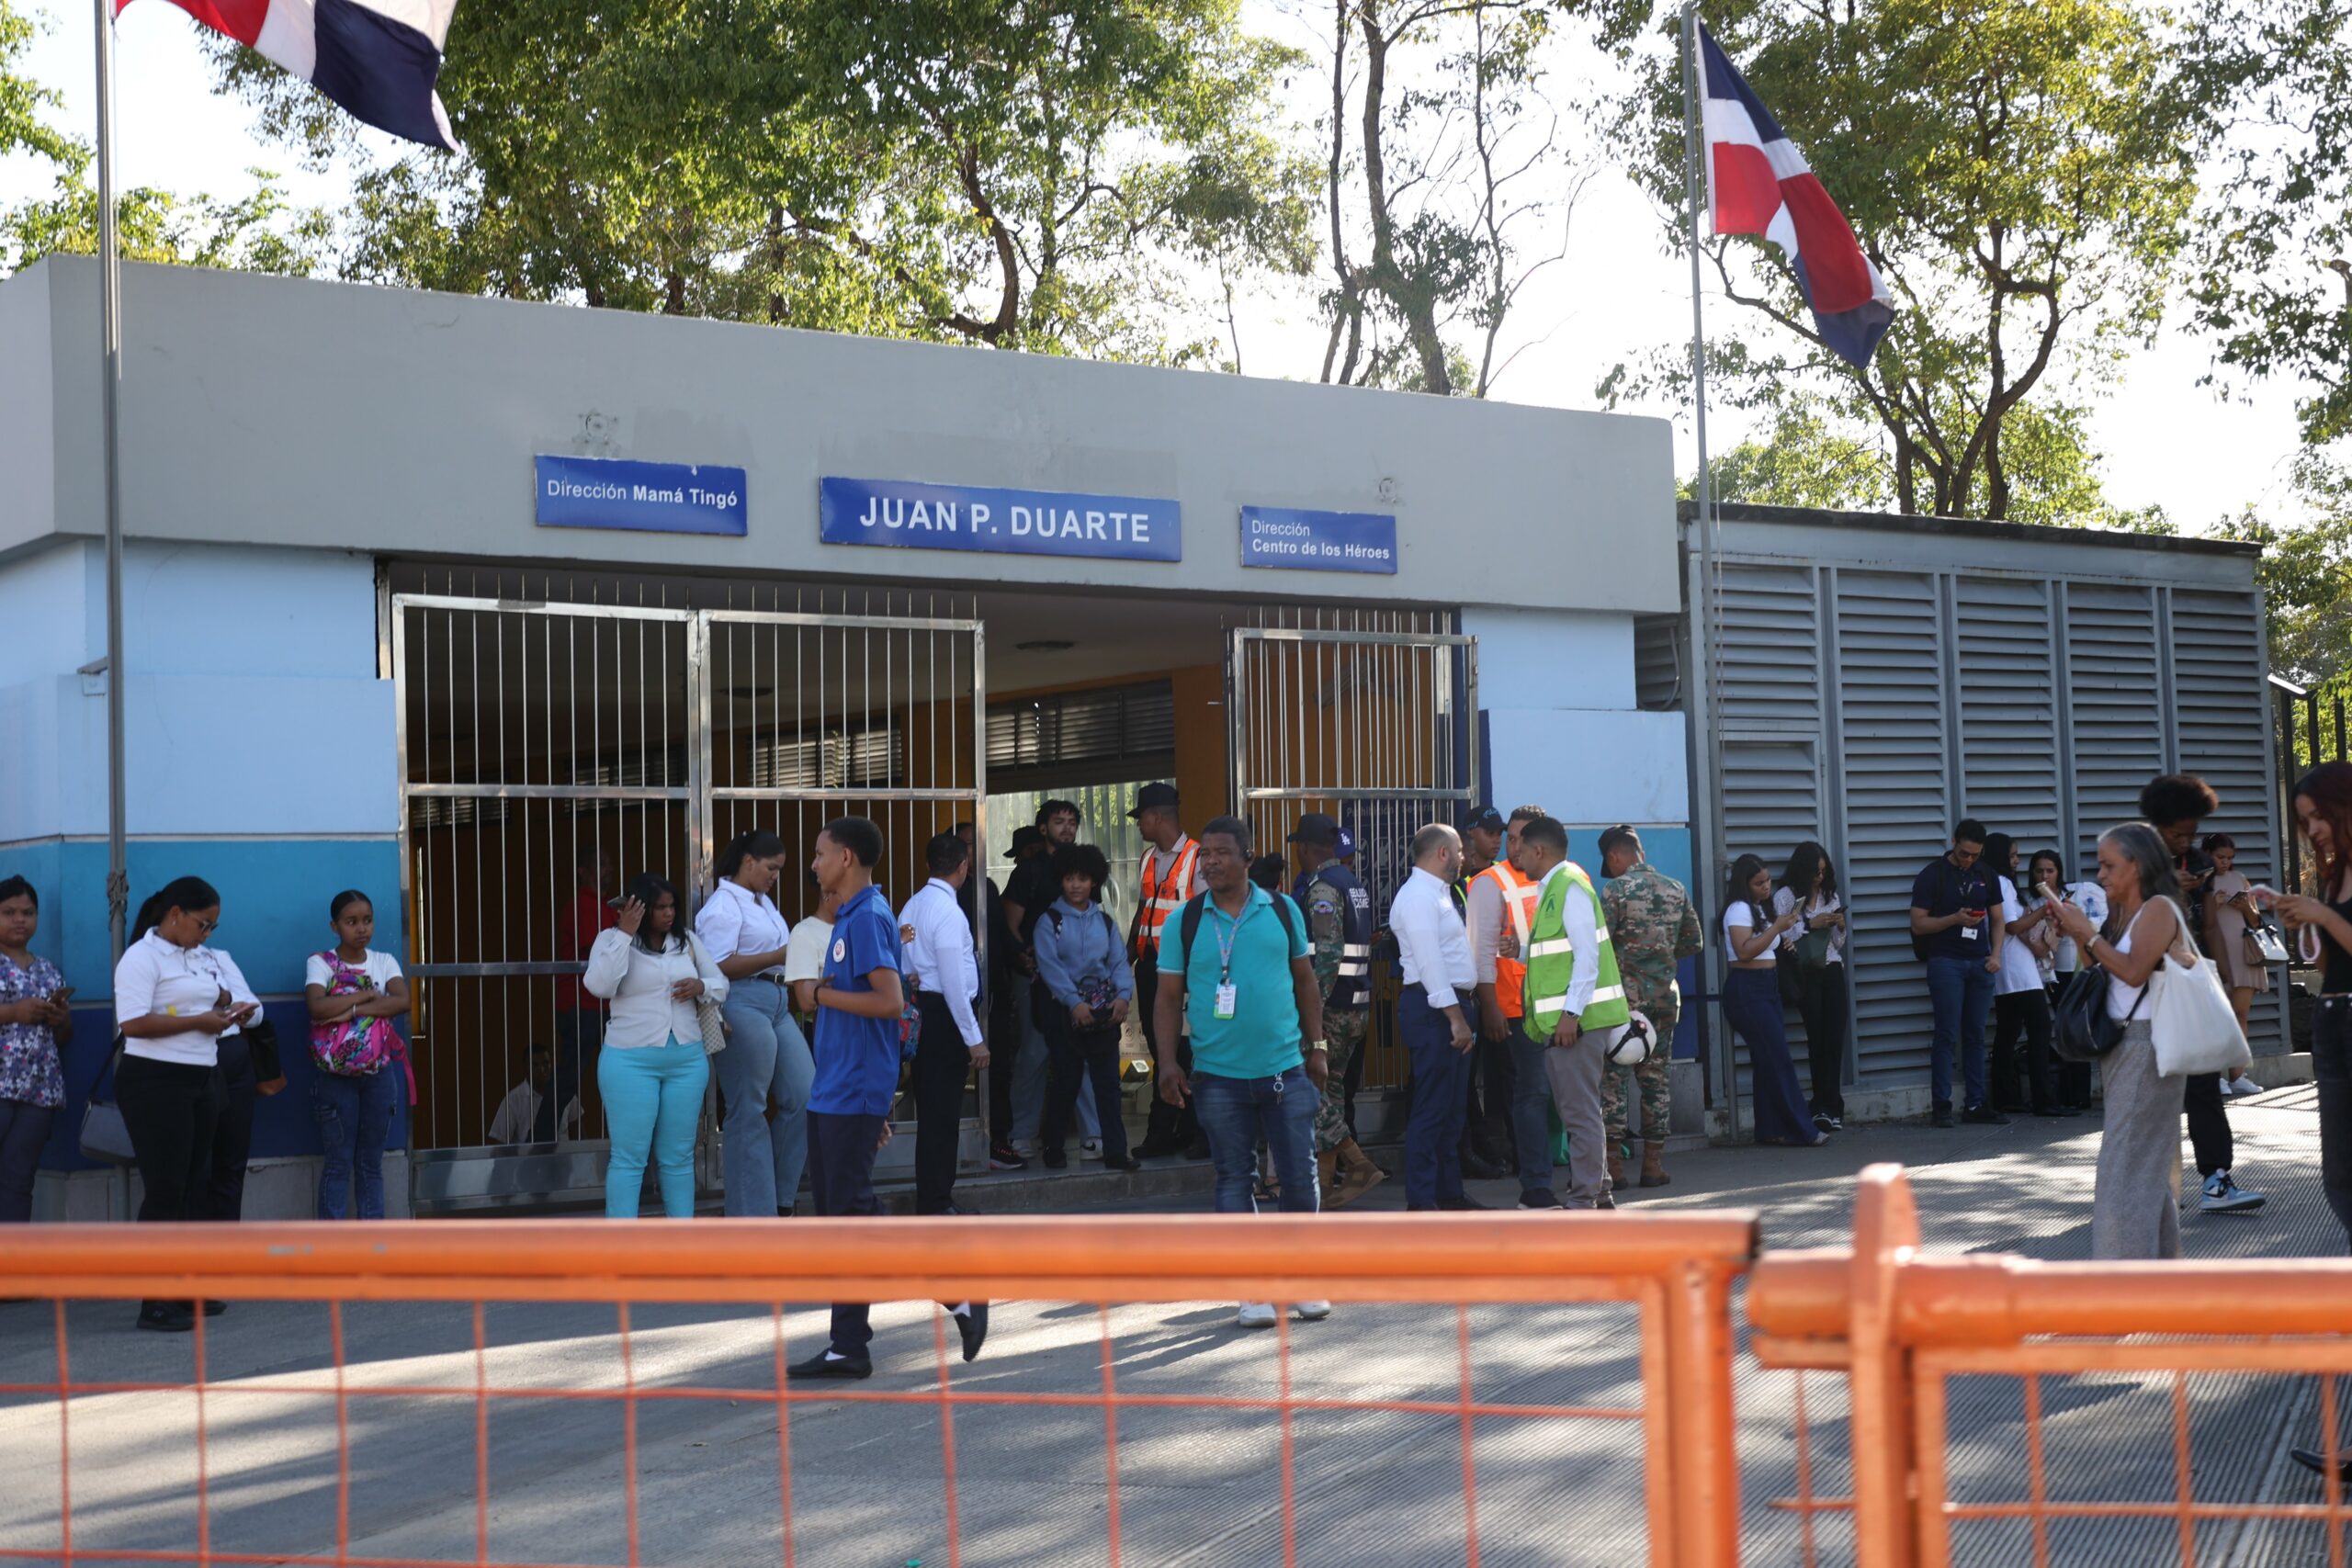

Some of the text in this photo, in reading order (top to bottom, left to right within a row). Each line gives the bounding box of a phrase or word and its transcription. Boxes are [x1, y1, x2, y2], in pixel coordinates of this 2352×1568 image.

[548, 479, 738, 509] Dirección Mamá Tingó
[860, 496, 1150, 543] JUAN P. DUARTE
[1251, 519, 1310, 537] Dirección
[1252, 537, 1390, 559] Centro de los Héroes
